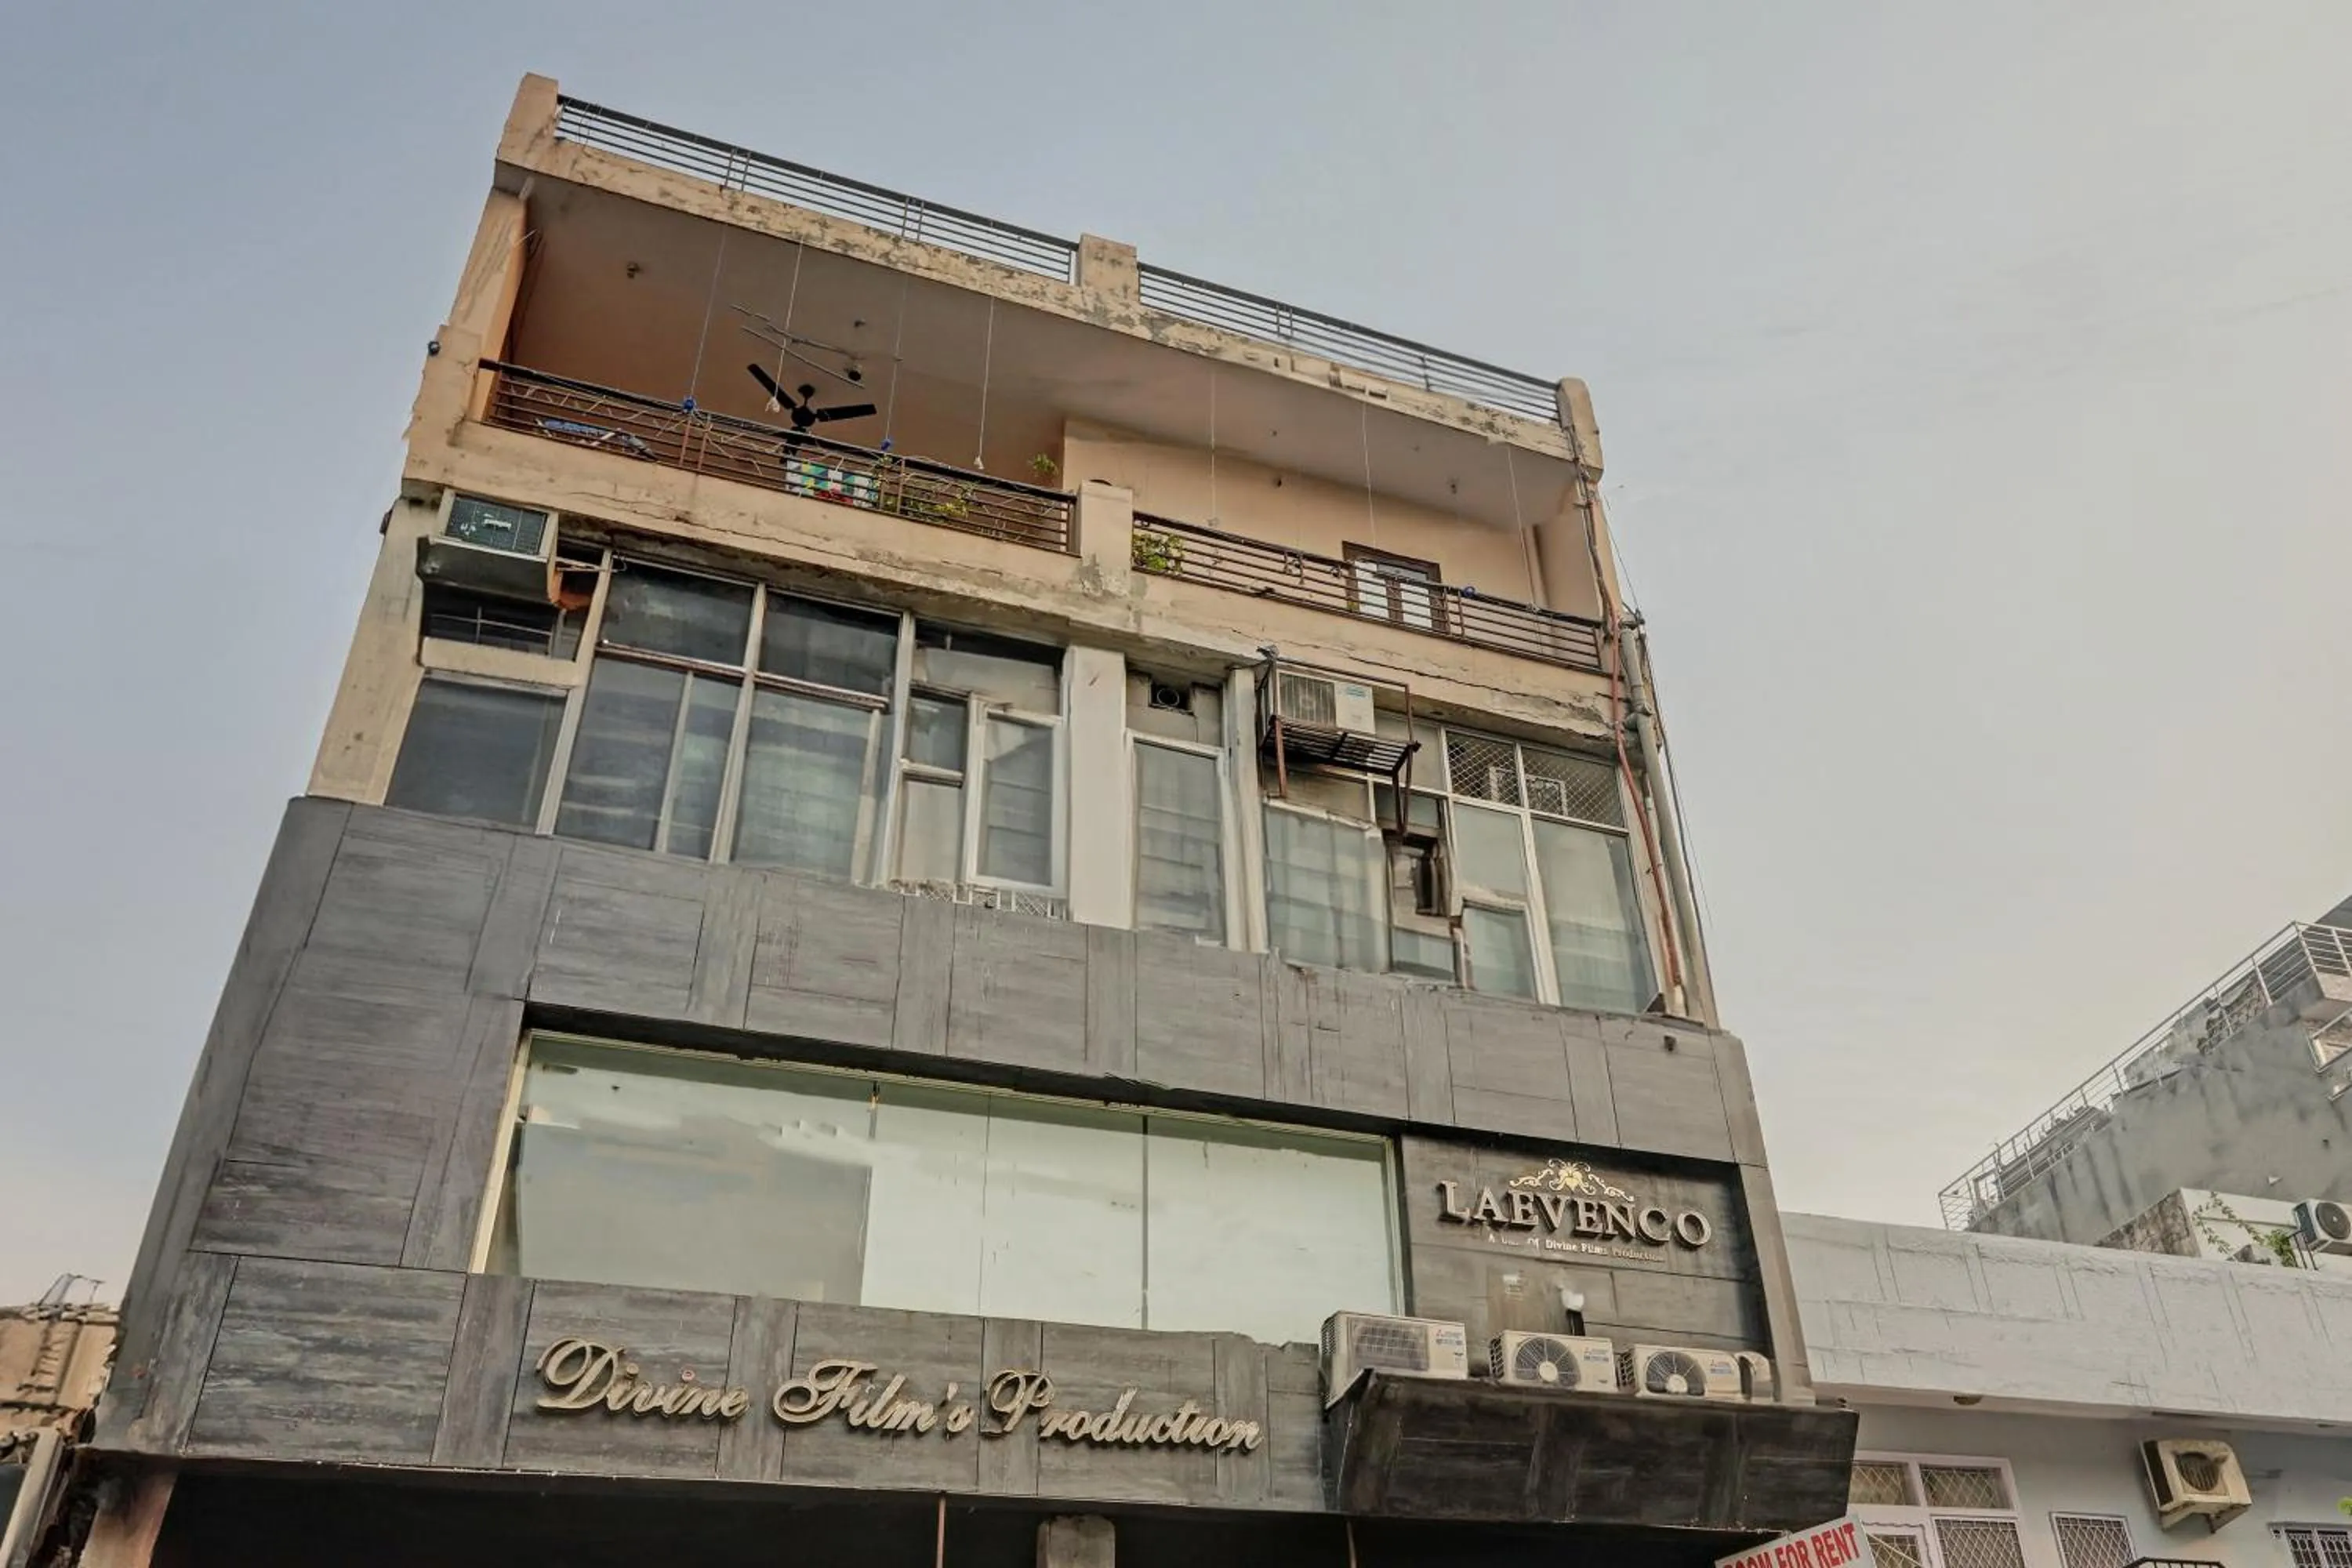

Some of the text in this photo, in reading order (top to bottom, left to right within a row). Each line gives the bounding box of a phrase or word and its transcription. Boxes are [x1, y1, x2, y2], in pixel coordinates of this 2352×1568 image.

[1438, 1180, 1712, 1247] LAEVENCO
[1545, 1238, 1578, 1252] Divine
[536, 1336, 1264, 1449] Divine Film's Production
[1774, 1539, 1813, 1568] FOR
[1811, 1522, 1860, 1568] RENT
